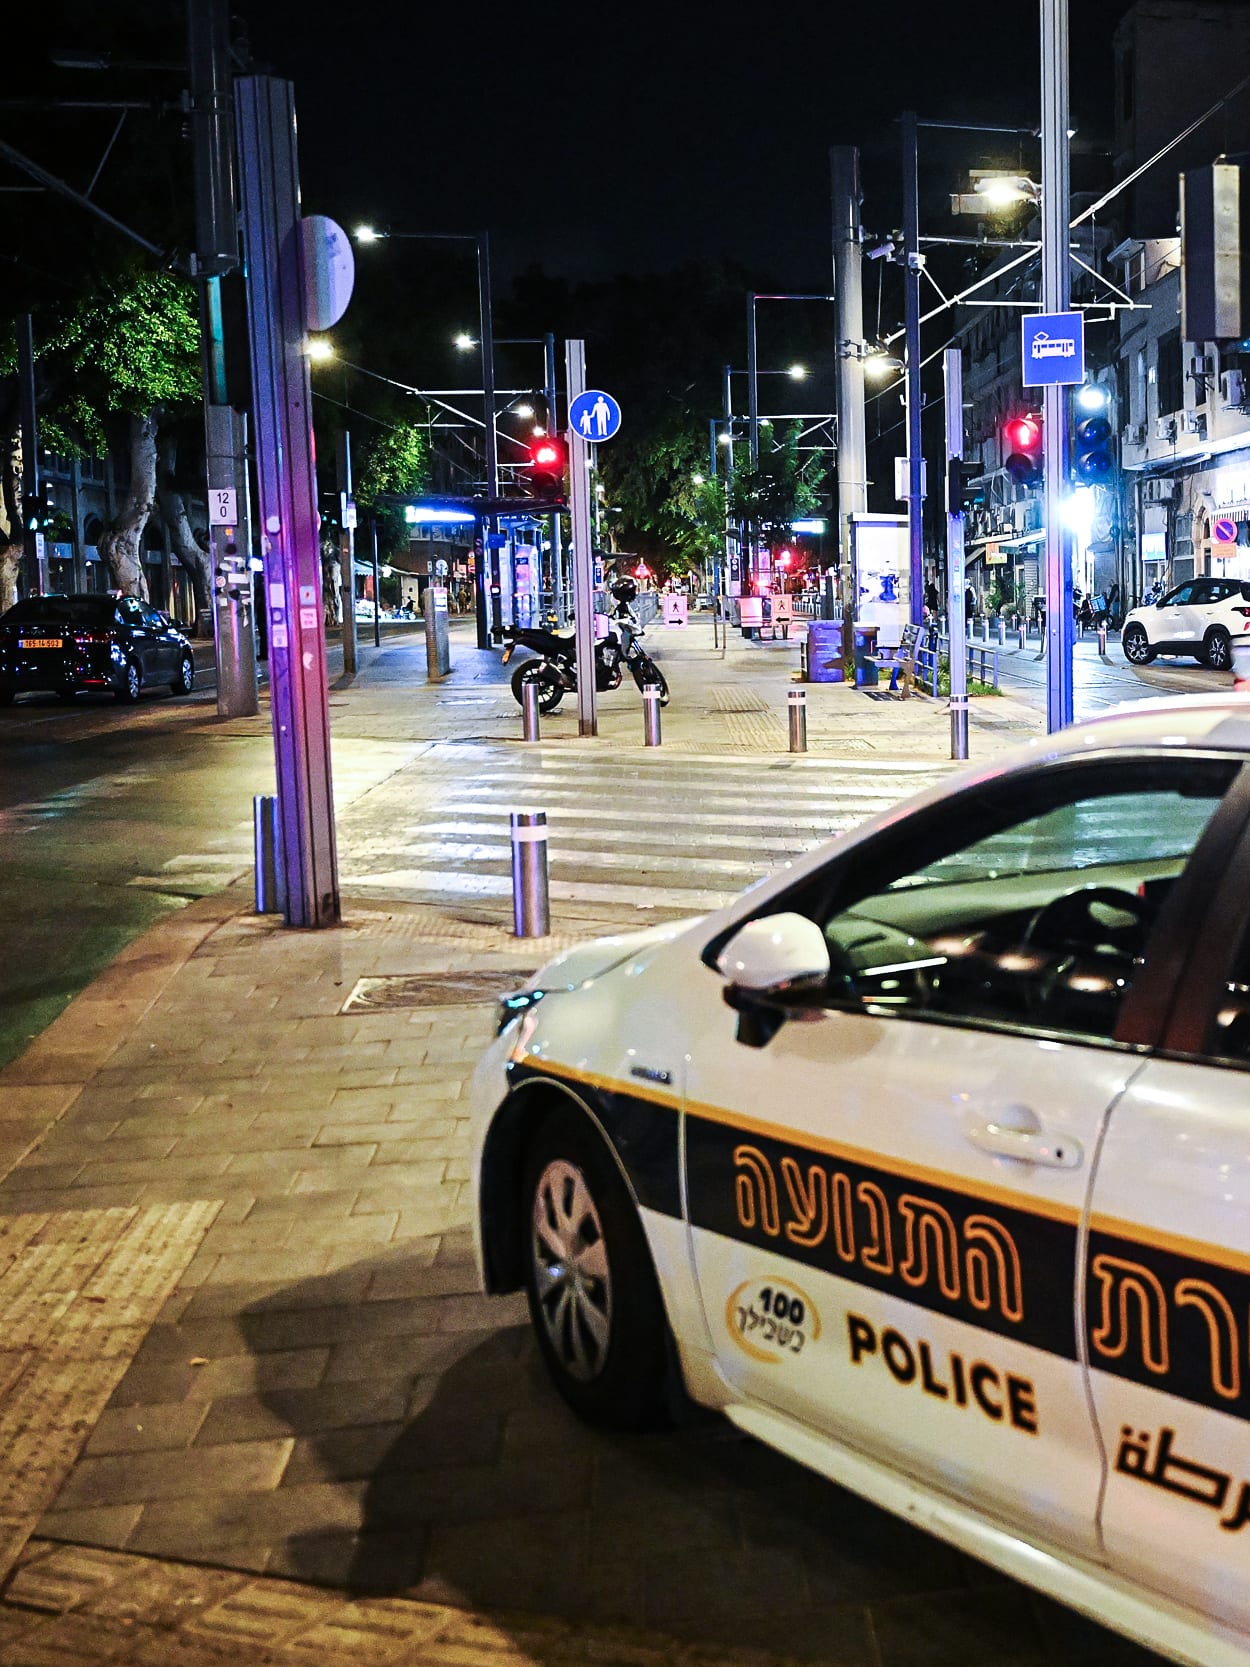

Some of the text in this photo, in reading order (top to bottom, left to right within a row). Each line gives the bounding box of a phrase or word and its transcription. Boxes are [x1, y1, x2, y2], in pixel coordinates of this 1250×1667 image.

[216, 492, 230, 504] 12
[733, 1144, 1024, 1324] התנועה
[737, 1304, 806, 1354] בשבילך
[759, 1286, 805, 1326] 100
[846, 1311, 1040, 1437] POLICE
